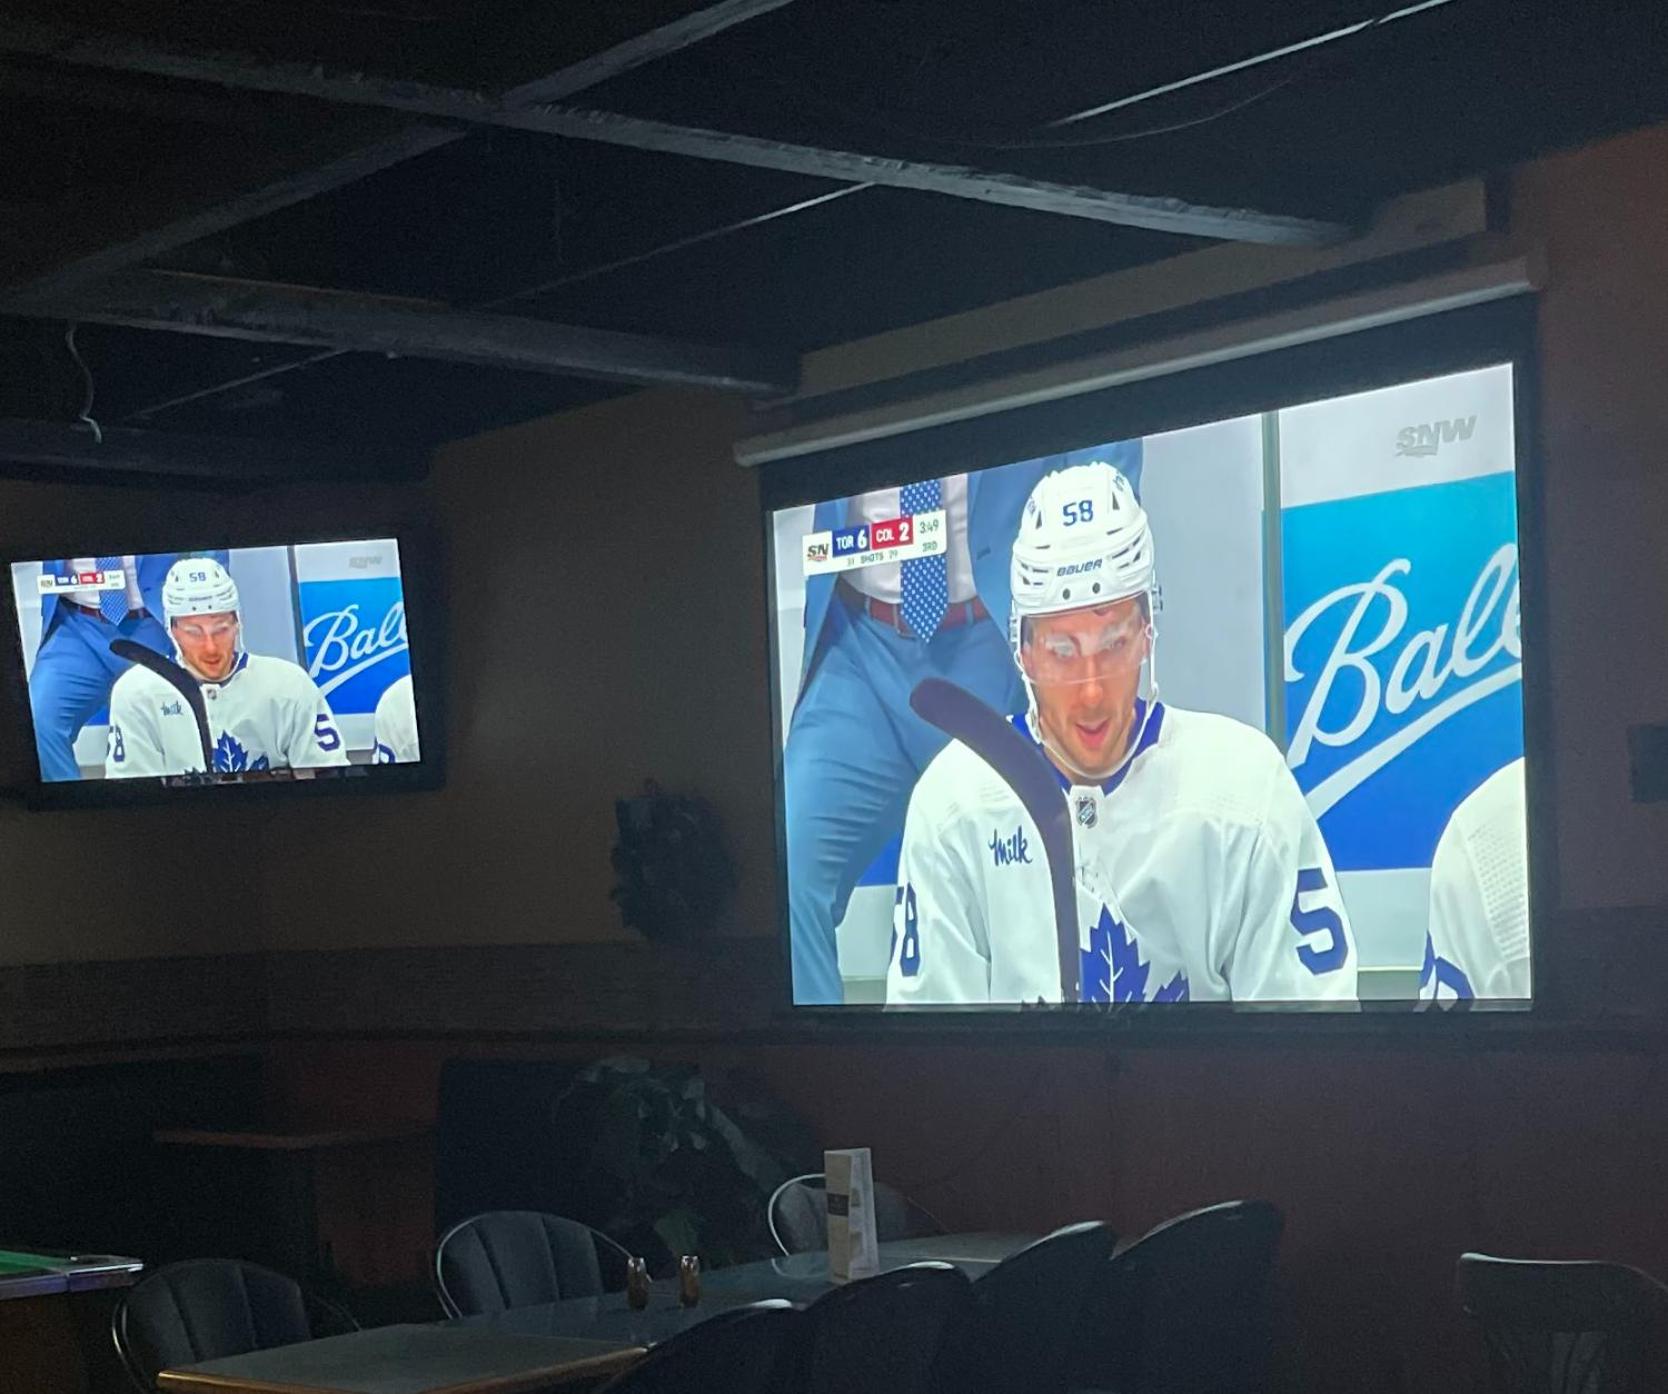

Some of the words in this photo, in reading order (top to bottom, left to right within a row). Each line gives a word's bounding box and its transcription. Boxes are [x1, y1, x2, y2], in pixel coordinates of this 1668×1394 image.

[1395, 415, 1477, 456] SNW
[1062, 499, 1094, 527] 58
[836, 534, 854, 550] TOR
[857, 529, 868, 549] 6
[875, 528, 895, 543] COL
[898, 522, 910, 541] 2
[806, 543, 830, 559] SN
[189, 571, 207, 582] 58
[1056, 558, 1103, 577] BAUER
[314, 713, 341, 752] 5
[988, 825, 1033, 867] Milk
[1290, 867, 1349, 976] 5
